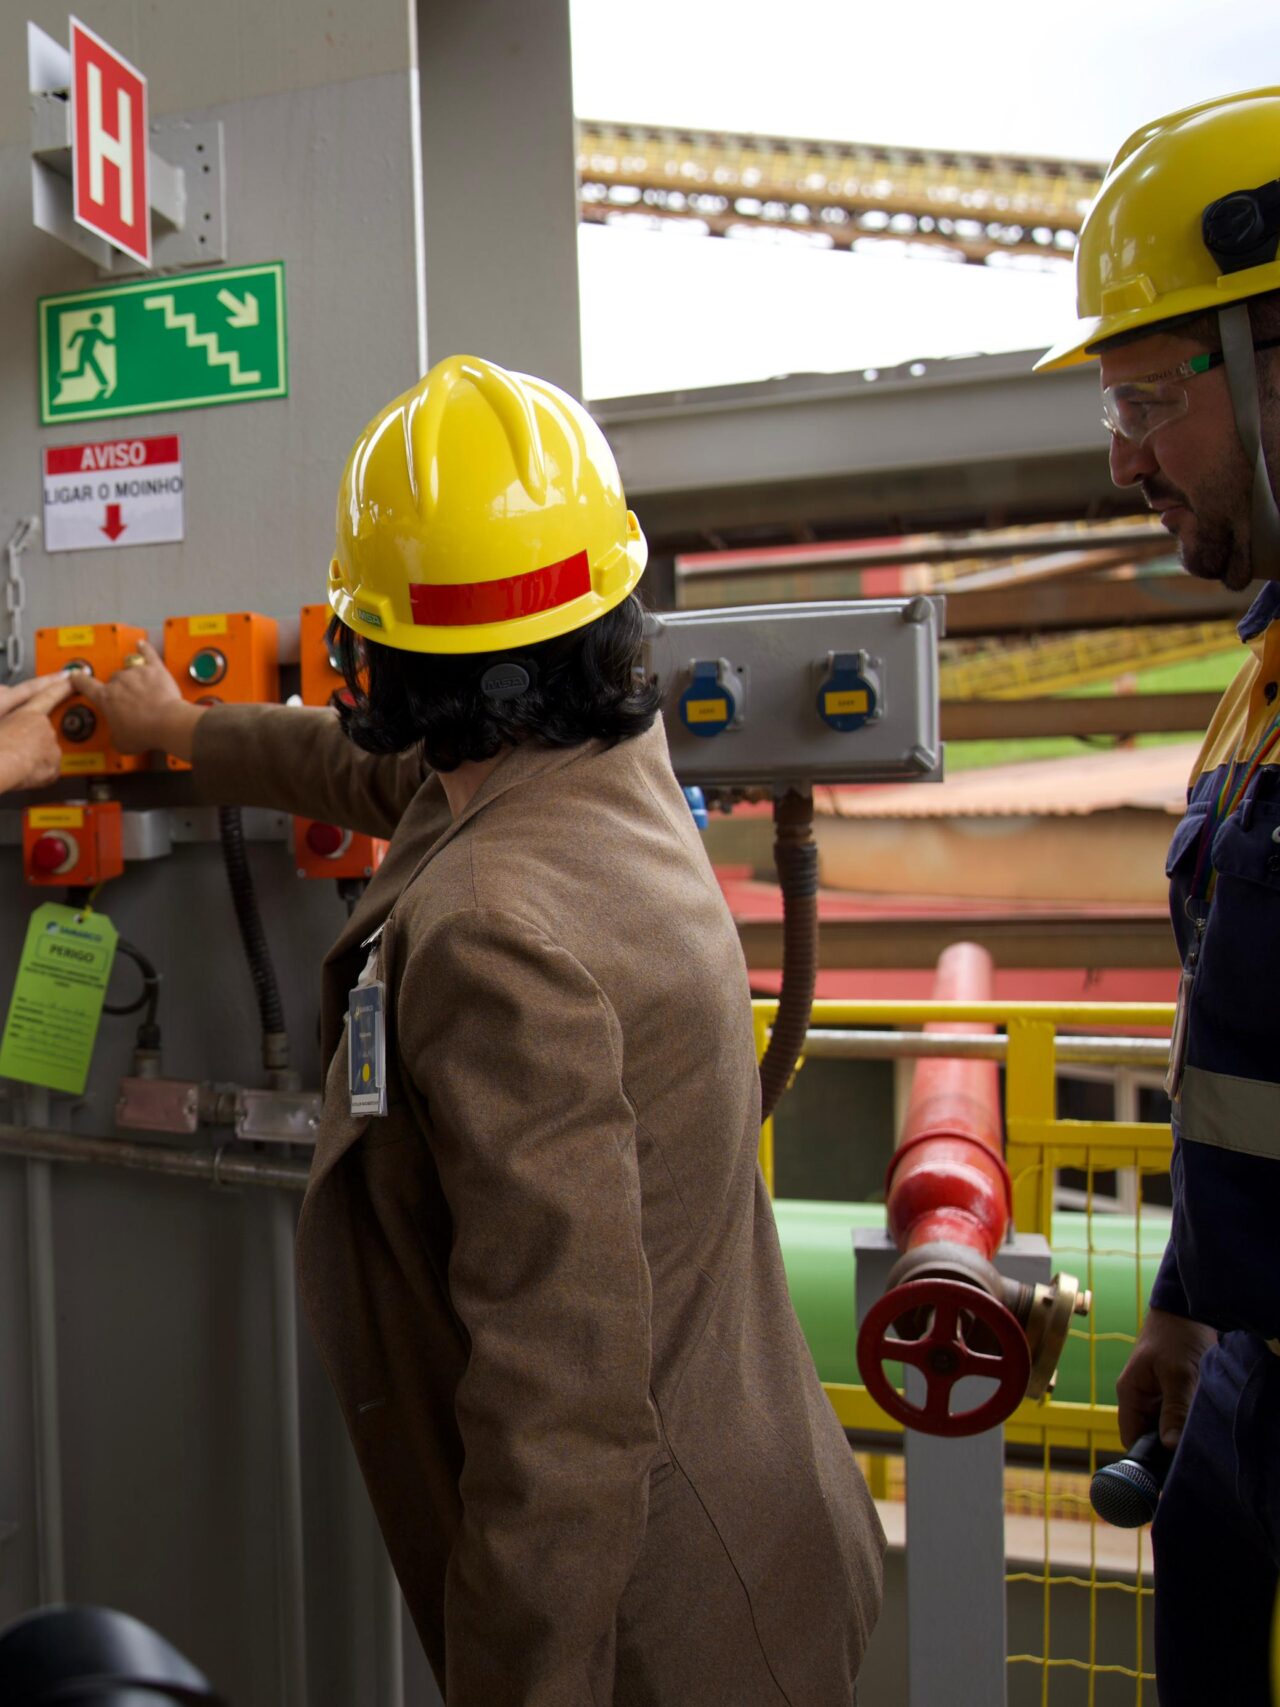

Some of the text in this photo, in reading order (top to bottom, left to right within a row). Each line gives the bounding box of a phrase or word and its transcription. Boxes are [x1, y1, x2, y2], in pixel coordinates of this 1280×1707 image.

[87, 61, 134, 228] H
[80, 441, 146, 471] AVISO
[44, 476, 184, 505] LIGAR O MOINHO
[357, 609, 381, 626] MSA
[485, 676, 525, 691] MSA
[49, 943, 95, 964] PERIGO
